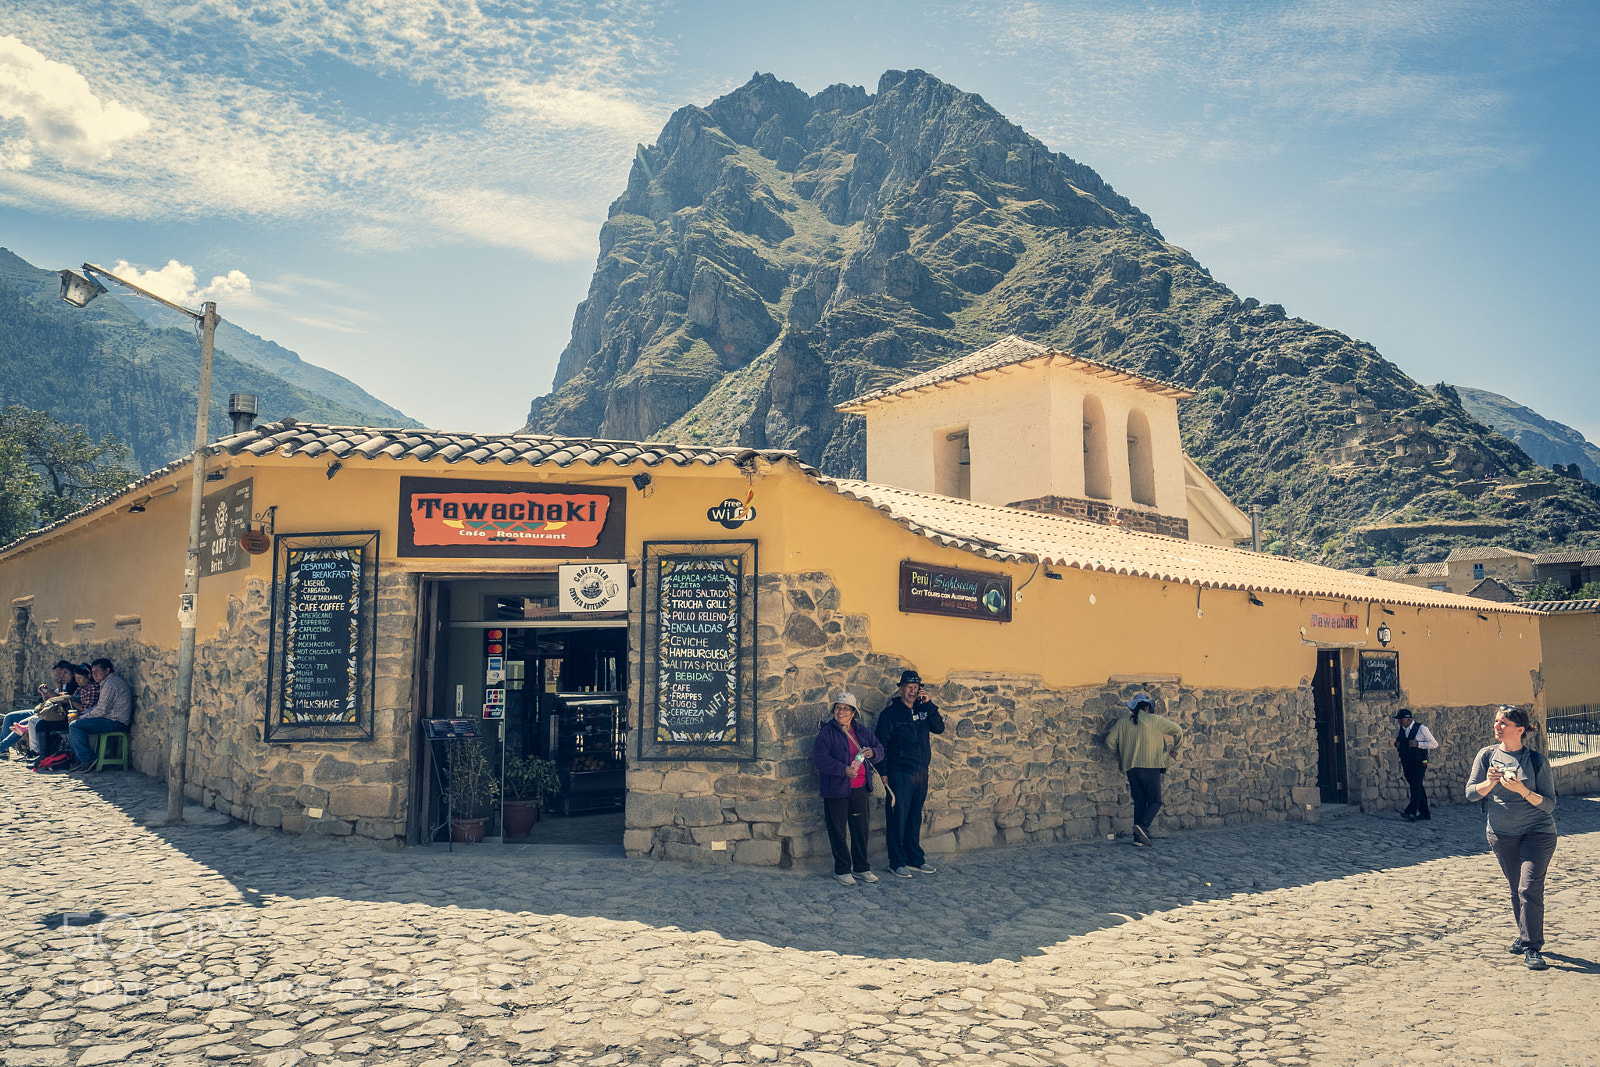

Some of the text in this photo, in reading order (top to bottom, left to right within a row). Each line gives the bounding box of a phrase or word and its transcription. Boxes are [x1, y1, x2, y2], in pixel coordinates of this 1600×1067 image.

[724, 500, 742, 508] Free
[417, 498, 597, 522] Tawachaki
[497, 530, 567, 540] Restaurant
[301, 562, 336, 571] DESAYUNO
[312, 570, 351, 579] BREAKFAST
[573, 566, 593, 583] CRAFT
[594, 566, 609, 581] BEER
[673, 574, 700, 582] ALPACA
[707, 574, 730, 582] SALSA
[912, 571, 978, 594] Perú Sightseeing
[672, 589, 729, 598] LOMO SALTADO
[569, 587, 610, 610] CERVEZA ARTESANAL
[672, 600, 728, 609] TRUCHA GRILL
[672, 611, 727, 621] POLLO RELLENO
[1311, 614, 1358, 629] Tawachaki
[671, 623, 723, 633] ENSALADAS
[670, 636, 709, 647] CEVICHE
[669, 647, 729, 660] HAMBURGUESA
[670, 660, 700, 670] ALITAS
[706, 661, 731, 672] POLLO
[675, 672, 714, 681] BEBIDAS
[672, 684, 691, 692] CAFE
[671, 692, 702, 701] FRAPPES
[296, 699, 340, 709] MILKSHAKE
[671, 700, 697, 709] JUGOS
[671, 708, 704, 717] CERVEZA
[670, 717, 704, 726] GASEOSA
